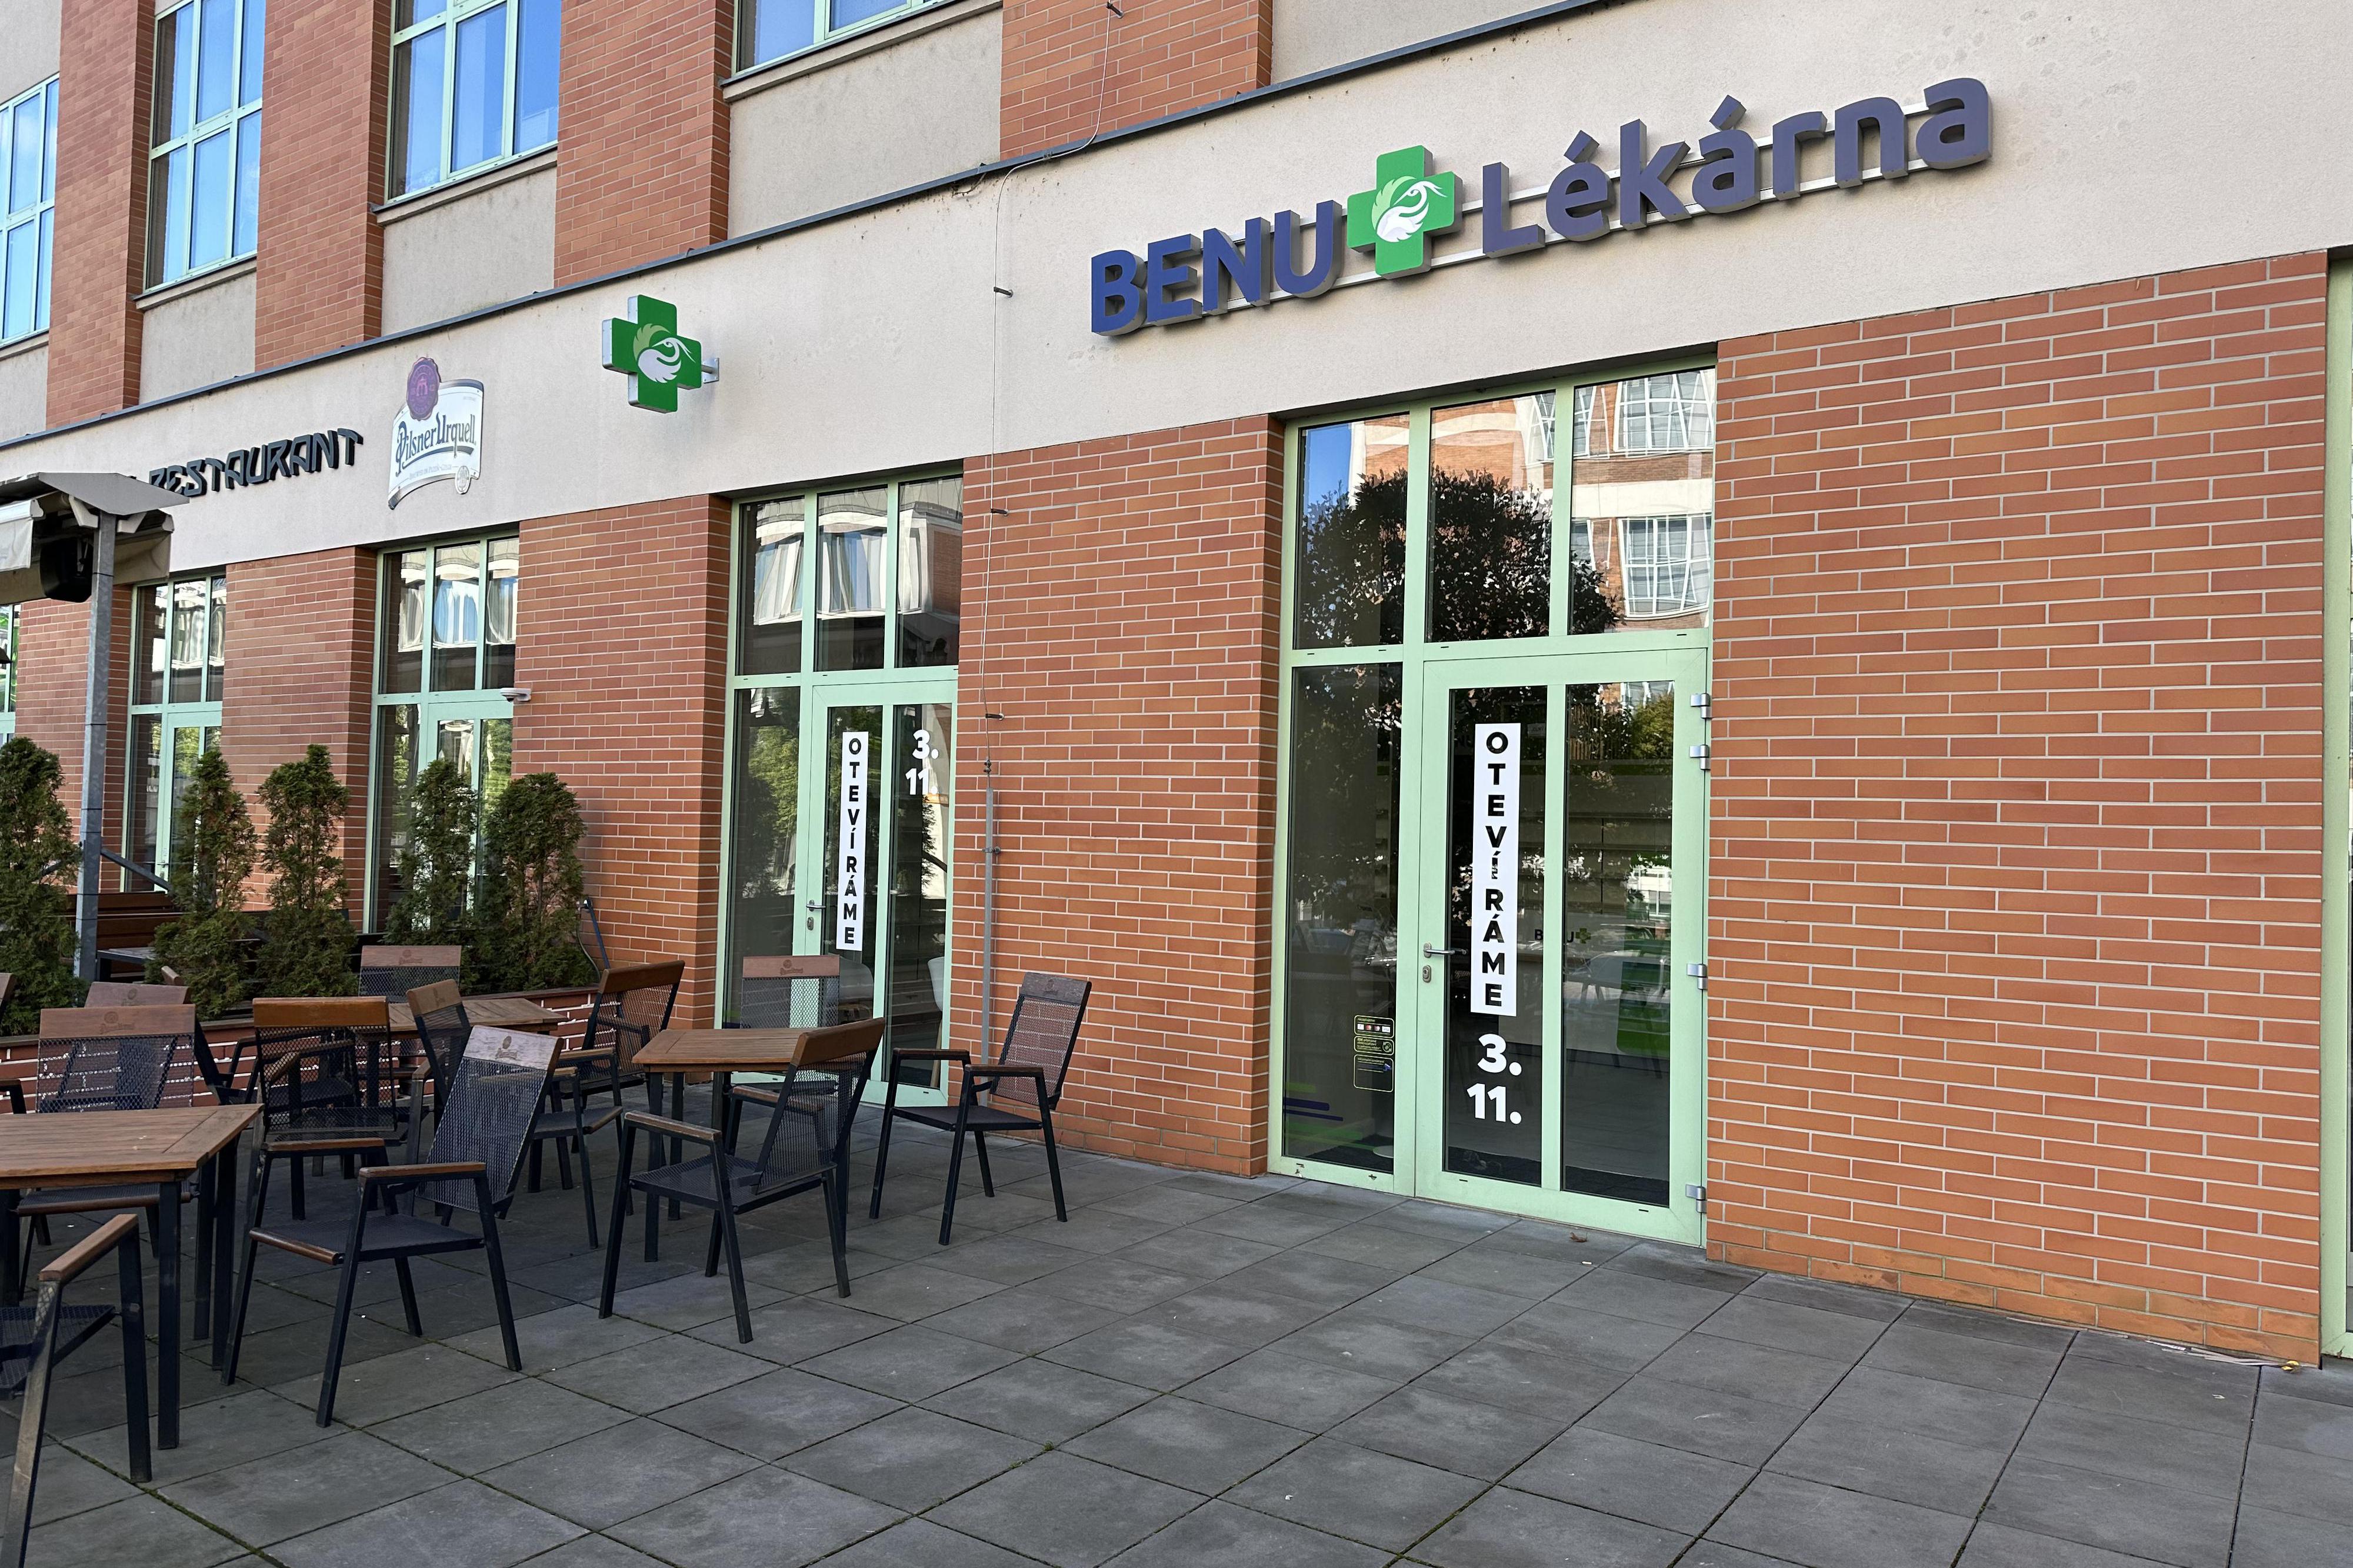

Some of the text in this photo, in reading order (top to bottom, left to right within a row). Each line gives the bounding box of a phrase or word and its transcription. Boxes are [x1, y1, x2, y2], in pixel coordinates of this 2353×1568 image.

[1092, 78, 1992, 336] BENU Lékárna
[395, 421, 436, 477] Pilsner
[843, 738, 861, 944] OTEVÍRÁME
[1482, 732, 1509, 1007] OTEVÍRÁME
[1467, 1083, 1522, 1124] 11.
[1477, 1034, 1522, 1076] 3.
